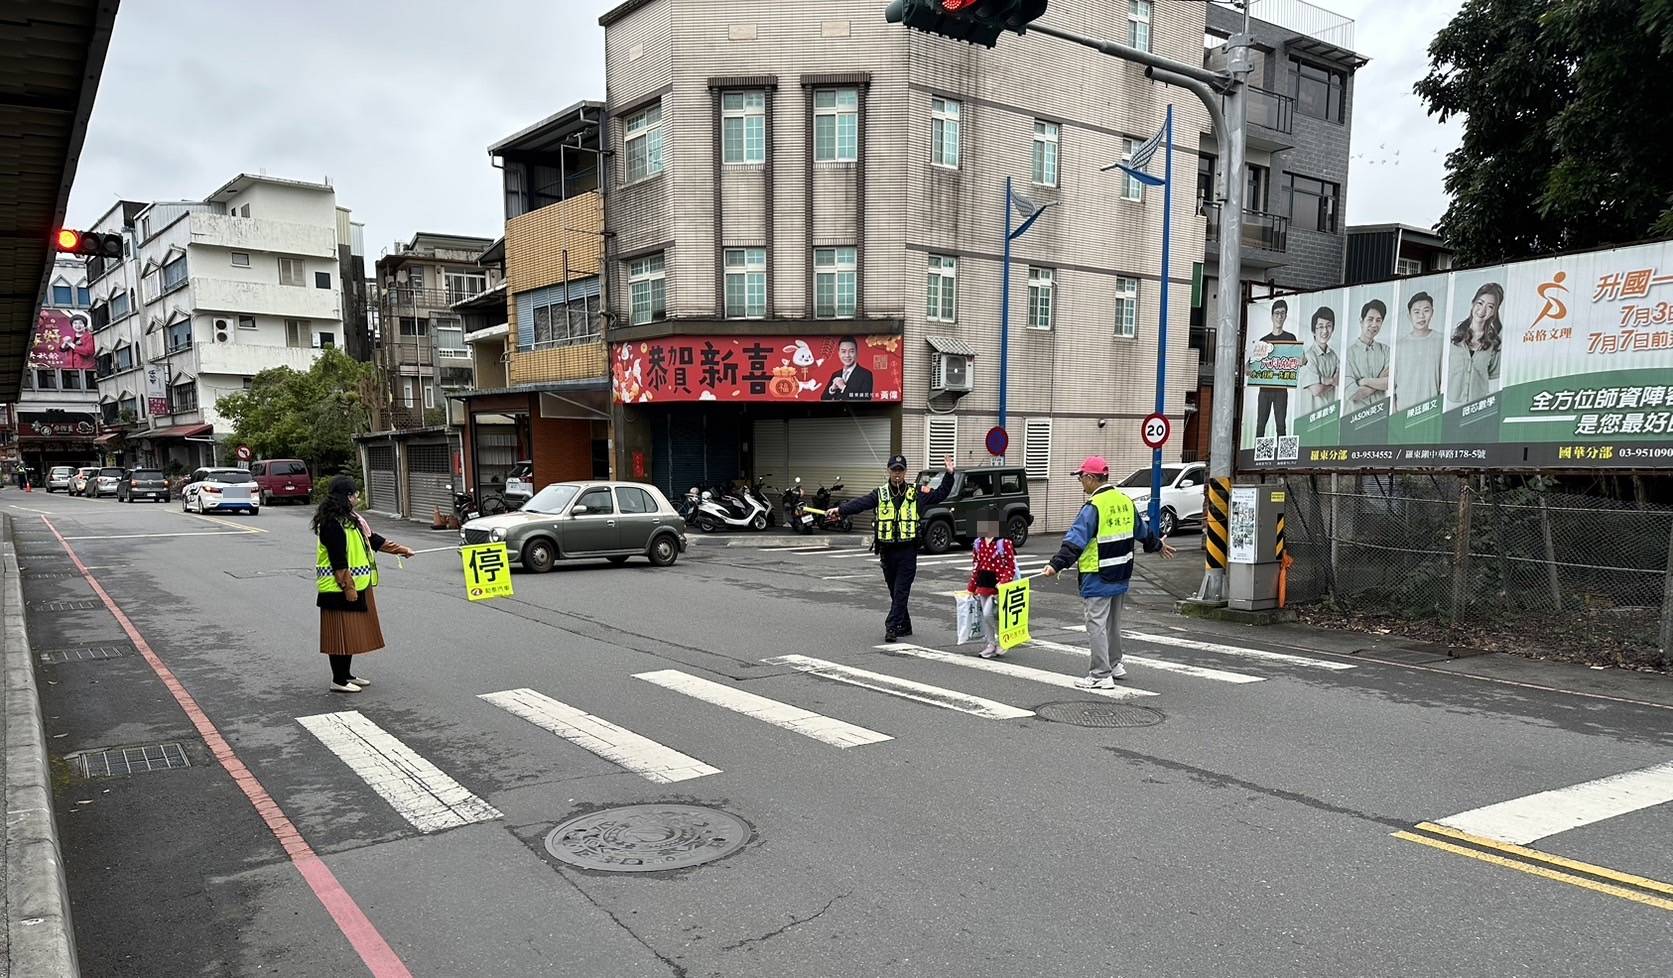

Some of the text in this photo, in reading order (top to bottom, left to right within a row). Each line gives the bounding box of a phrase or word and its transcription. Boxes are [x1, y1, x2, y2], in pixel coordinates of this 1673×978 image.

[1523, 327, 1572, 343] 高格文理
[647, 340, 774, 394] 恭賀新喜
[1147, 424, 1164, 437] 20
[1311, 449, 1348, 461] 羅東分部
[1351, 451, 1393, 459] 03-9534552
[1558, 446, 1613, 459] 國華分部
[469, 548, 502, 583] 停
[1002, 585, 1026, 629] 停
